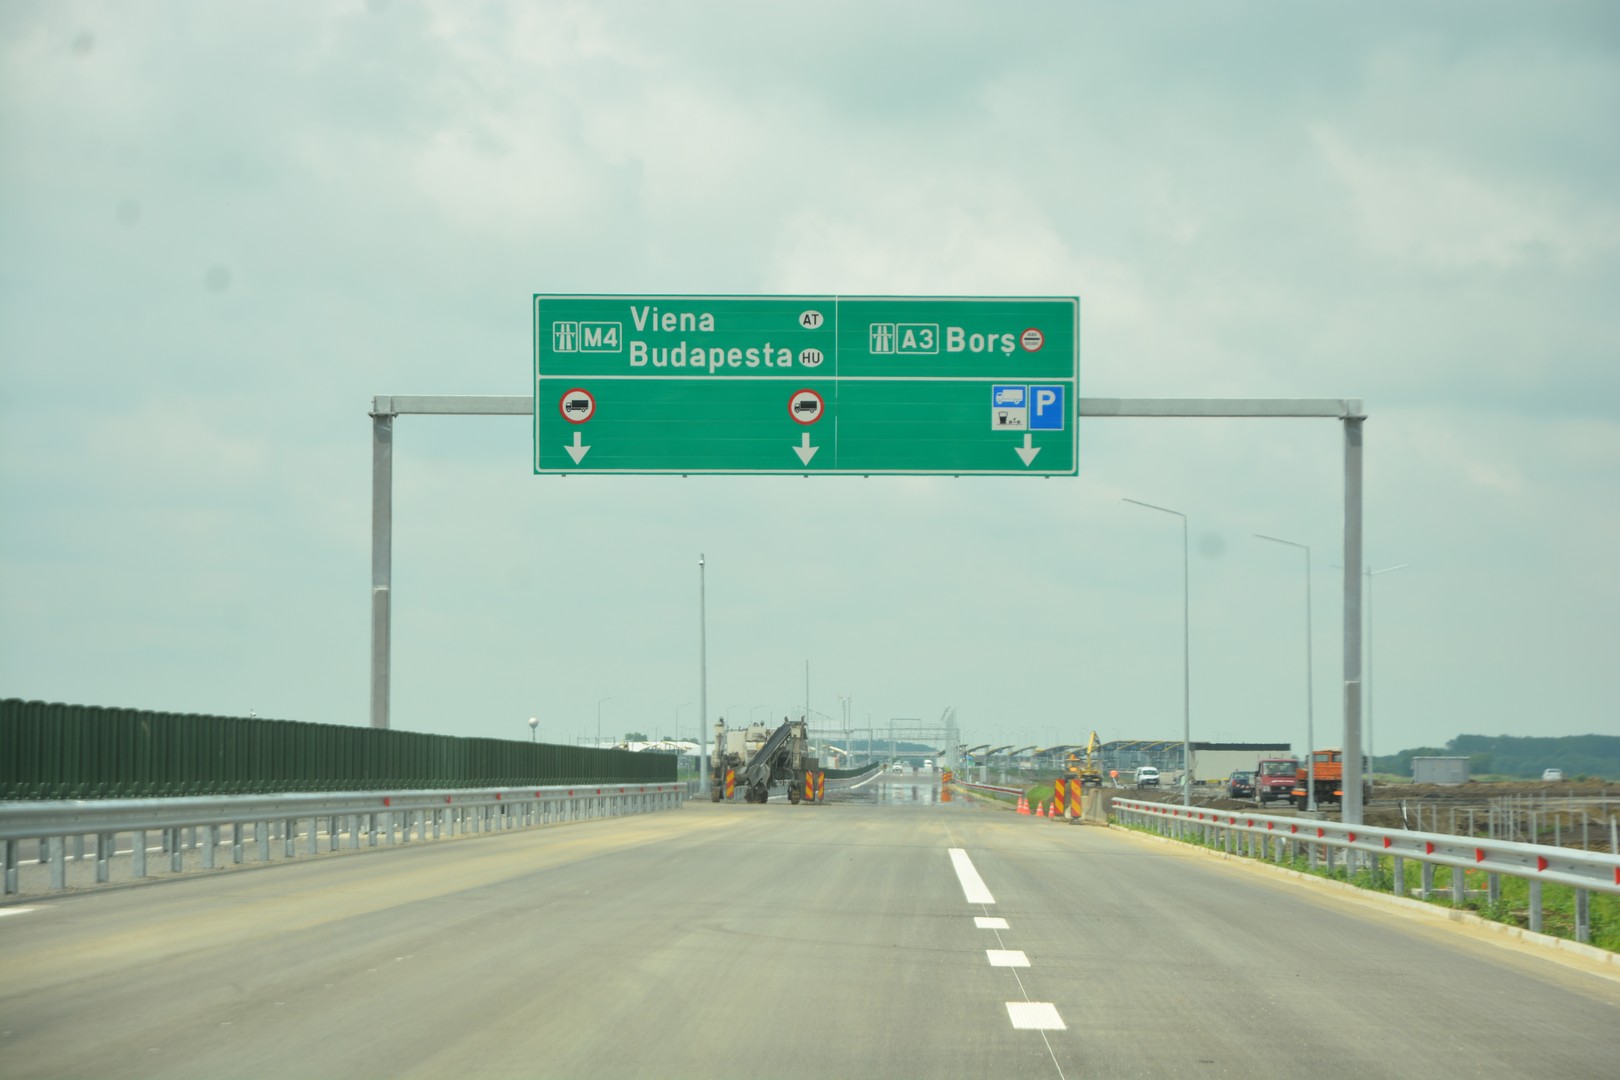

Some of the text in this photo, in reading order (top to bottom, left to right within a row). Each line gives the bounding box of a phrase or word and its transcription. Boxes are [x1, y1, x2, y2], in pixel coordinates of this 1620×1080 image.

[630, 306, 820, 332] Viena AT
[584, 327, 618, 347] M4
[902, 329, 934, 349] A3
[946, 326, 1016, 356] Borș
[630, 341, 821, 374] Budapesta HU
[1037, 390, 1056, 416] P
